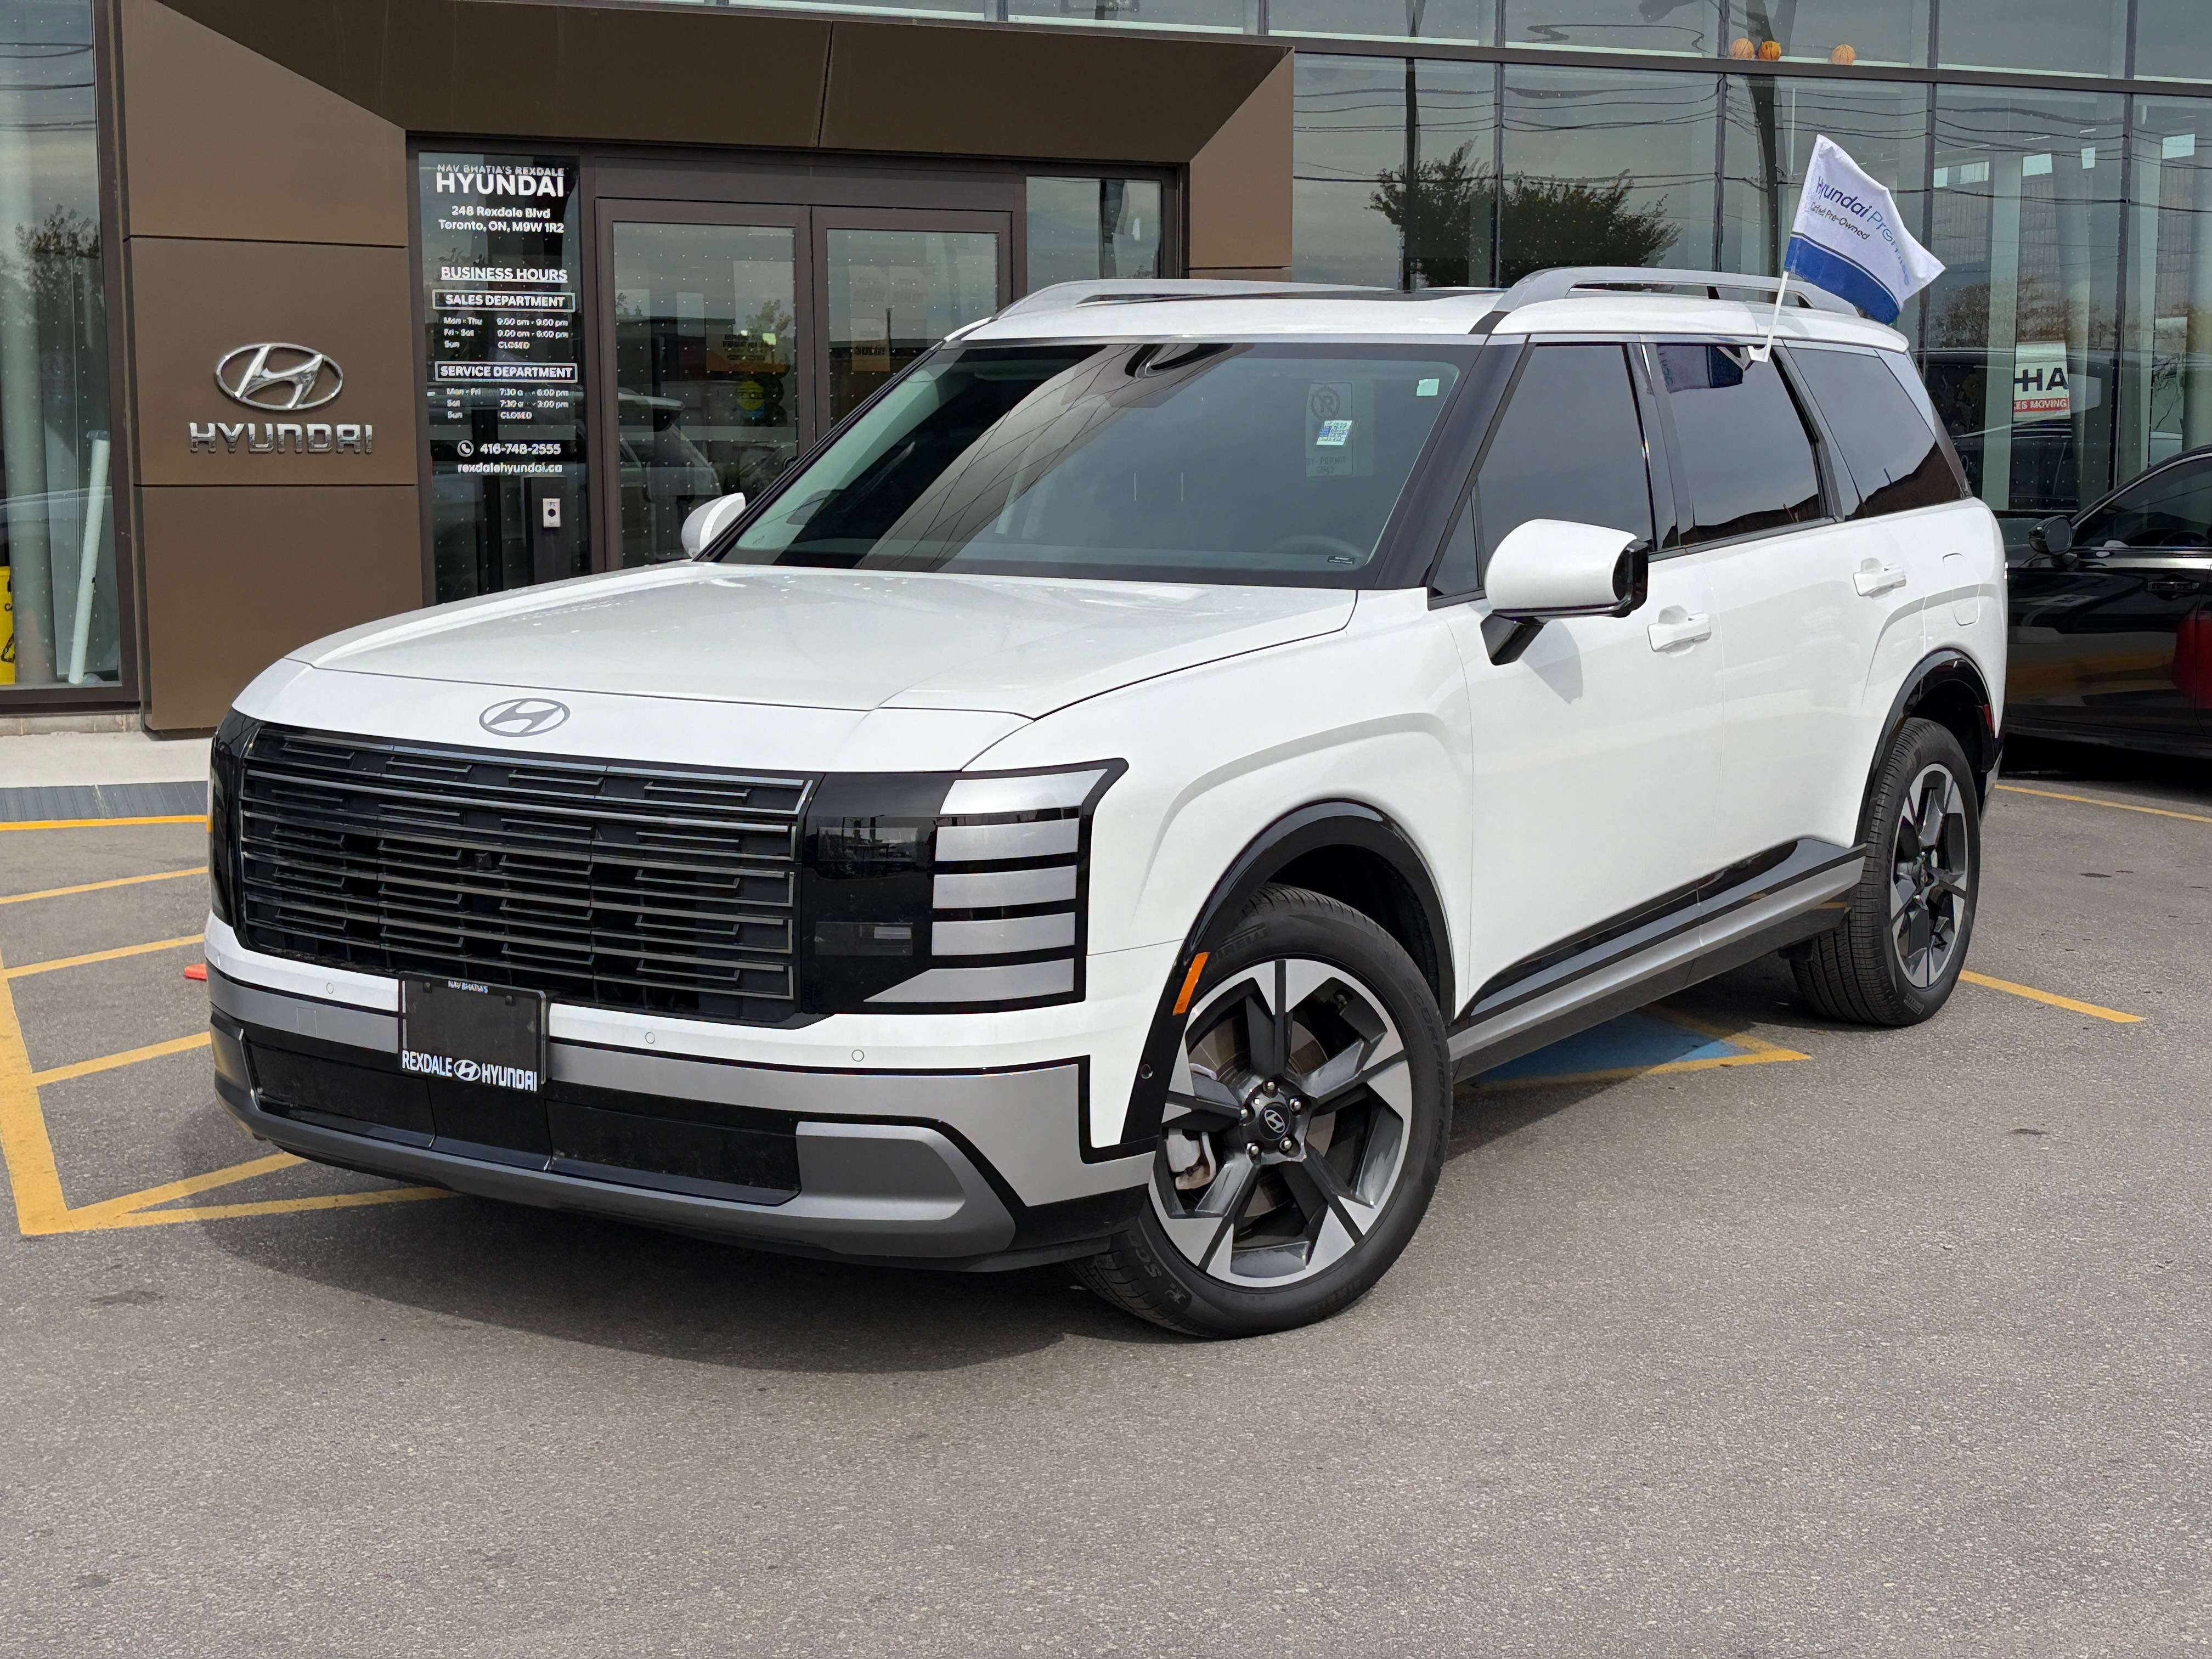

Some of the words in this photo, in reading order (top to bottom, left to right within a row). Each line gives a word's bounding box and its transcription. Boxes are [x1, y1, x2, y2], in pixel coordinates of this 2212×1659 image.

[437, 163, 459, 172] NAV
[464, 165, 512, 175] BHATIA'S
[515, 166, 565, 177] REXDALE
[436, 172, 564, 197] HYUNDAI
[1816, 176, 1872, 217] Hyundai
[452, 205, 474, 217] 248
[477, 206, 523, 218] Rexdale
[525, 208, 551, 218] Blvd
[438, 219, 487, 232] Toronto,
[488, 221, 510, 233] ON,
[512, 222, 543, 233] M9W
[544, 223, 565, 233] 1R2
[1825, 210, 1870, 240] Pre-Owned
[441, 267, 514, 280] BUSINESS
[517, 268, 568, 280] HOURS
[445, 294, 483, 305] SALES
[485, 296, 565, 307] DEPARTMENT
[440, 365, 491, 377] SERVICE
[493, 366, 573, 378] DEPARTMENT
[2030, 399, 2067, 409] MOVING
[189, 422, 373, 454] HYUNDAI
[479, 443, 561, 455] 416-748-2555
[458, 462, 563, 475] rexdalehyundai.ca
[402, 1050, 452, 1077] REXDALE
[482, 1063, 537, 1091] HYUNDAI
